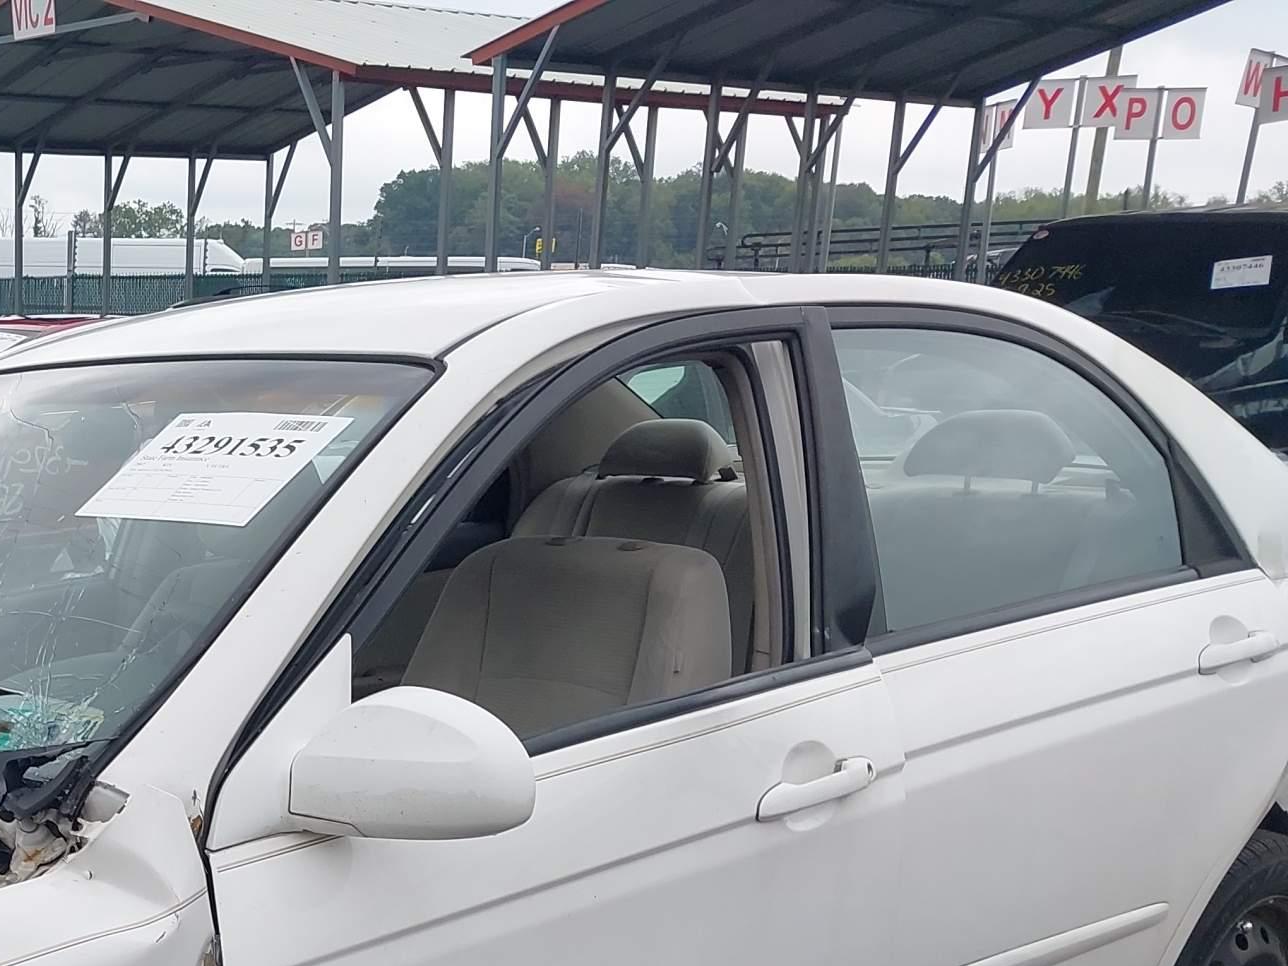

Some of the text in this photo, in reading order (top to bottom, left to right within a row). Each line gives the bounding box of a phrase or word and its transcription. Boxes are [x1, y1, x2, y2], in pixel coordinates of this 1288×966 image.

[1038, 84, 1124, 120] Y X
[1125, 96, 1196, 131] P O
[294, 233, 319, 247] G F
[161, 435, 306, 458] 43291535
